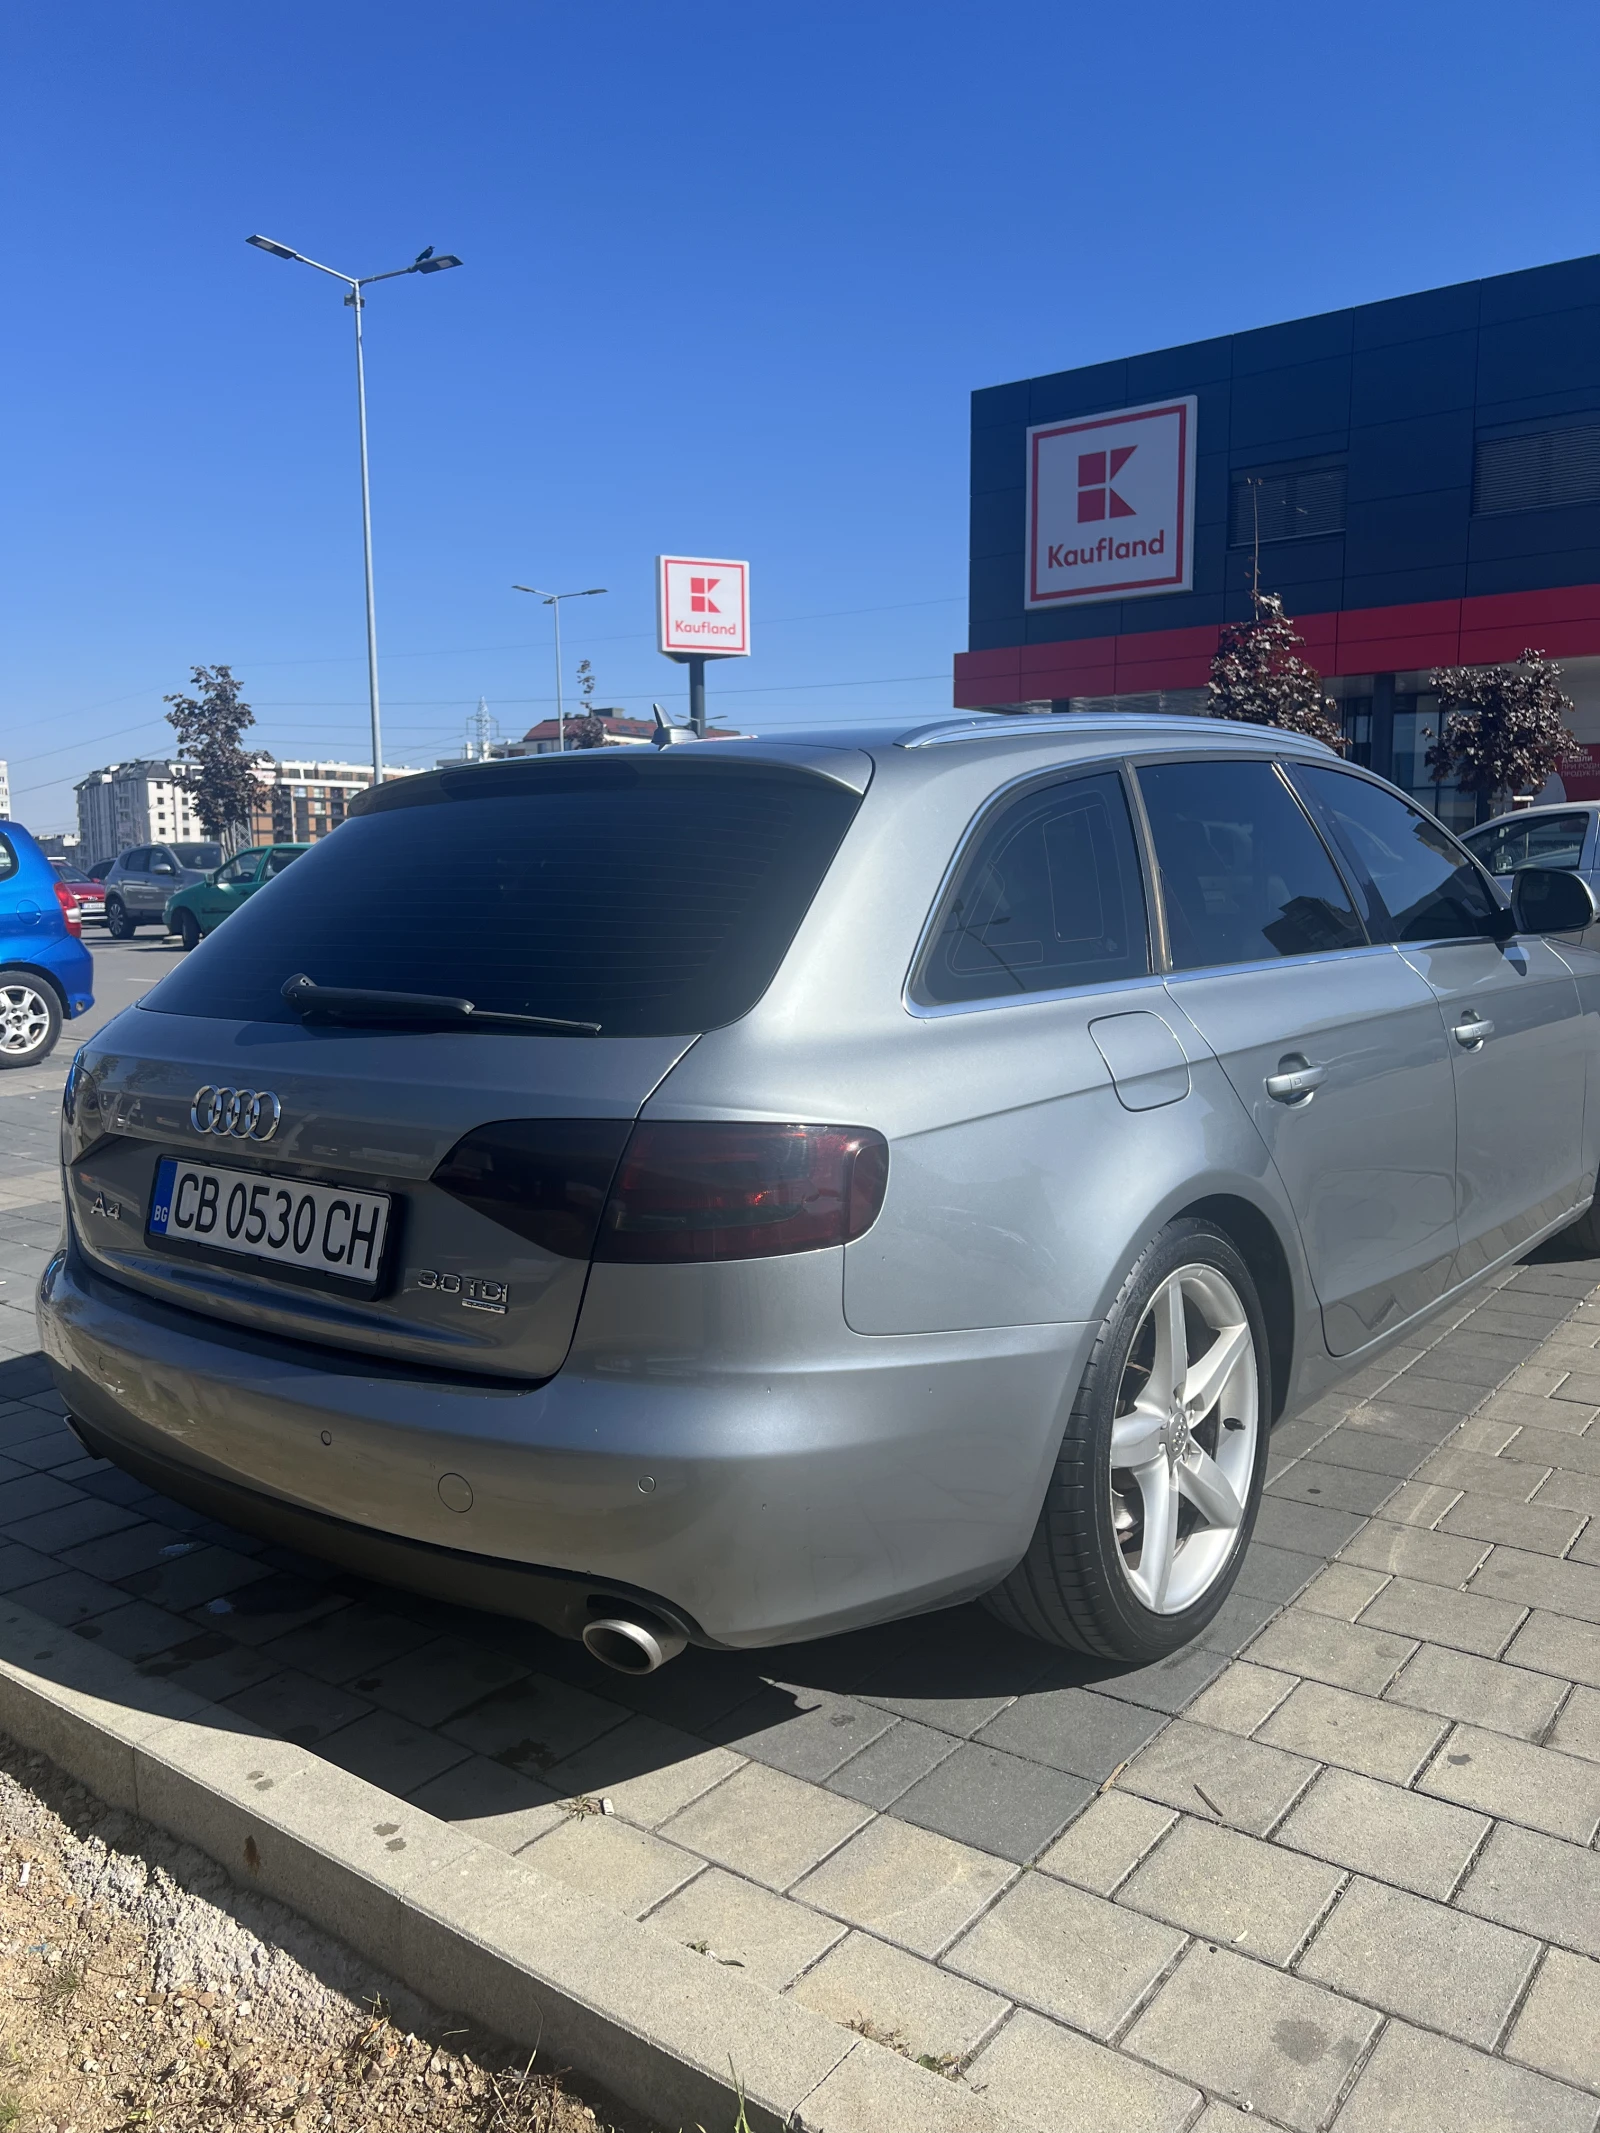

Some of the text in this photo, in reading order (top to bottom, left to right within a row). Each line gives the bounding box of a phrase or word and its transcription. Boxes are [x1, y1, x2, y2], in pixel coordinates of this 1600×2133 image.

[1048, 529, 1164, 569] Kaufland
[675, 620, 736, 635] Kaufland
[90, 1191, 120, 1219] A4
[154, 1205, 168, 1223] BG
[226, 1182, 316, 1254] 0530
[417, 1269, 509, 1302] 3.0 TDI
